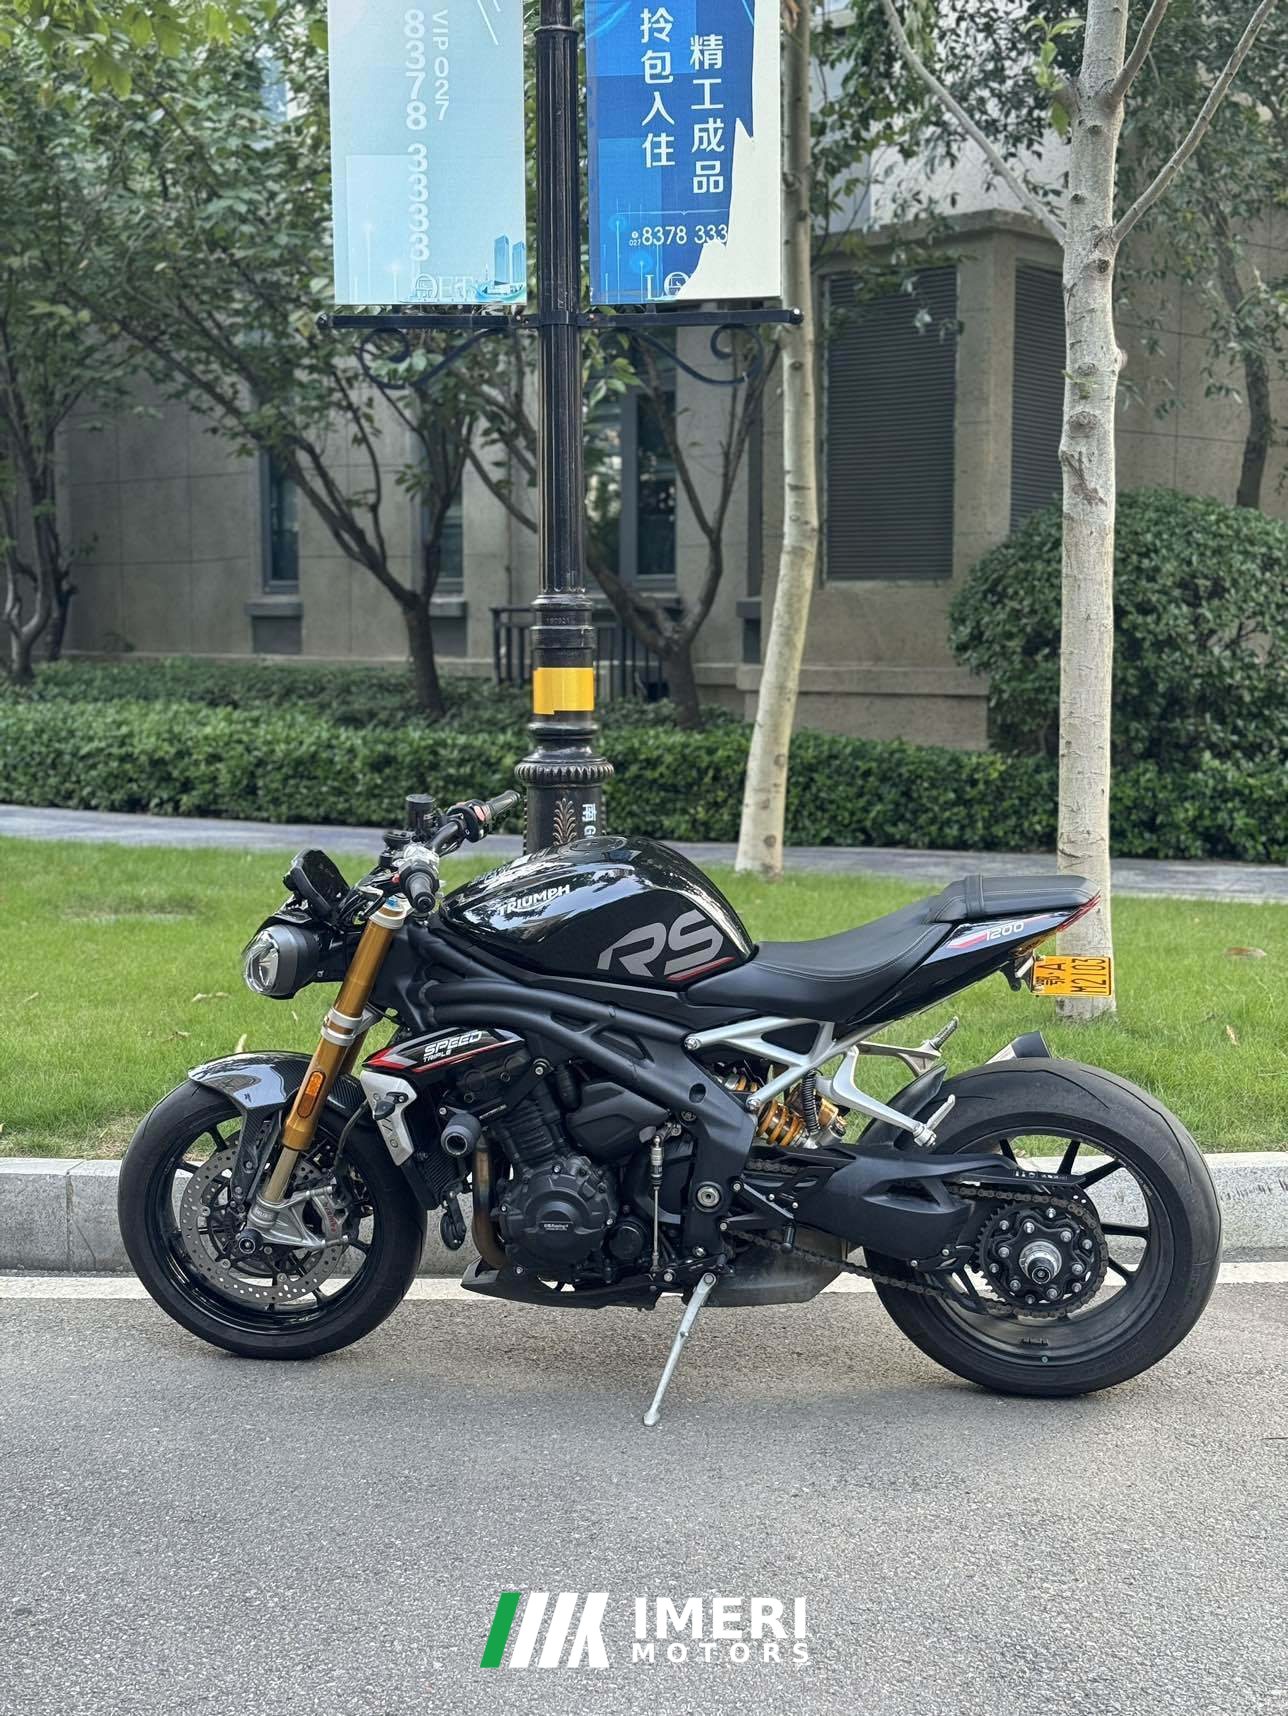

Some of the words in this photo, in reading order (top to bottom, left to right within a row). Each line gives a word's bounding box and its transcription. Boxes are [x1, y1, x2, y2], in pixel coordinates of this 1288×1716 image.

[432, 9, 449, 50] VIP
[404, 9, 428, 130] 8378
[434, 57, 449, 121] 027
[640, 7, 676, 168] 拎包入住
[690, 34, 725, 194] 精工成品
[407, 143, 430, 261] 3333
[642, 225, 687, 245] 8378
[499, 884, 571, 915] TRIUMPH
[596, 909, 724, 977] RS
[986, 921, 1024, 941] 1200
[423, 1030, 483, 1057] SPEED
[423, 1049, 451, 1063] TRIPLE
